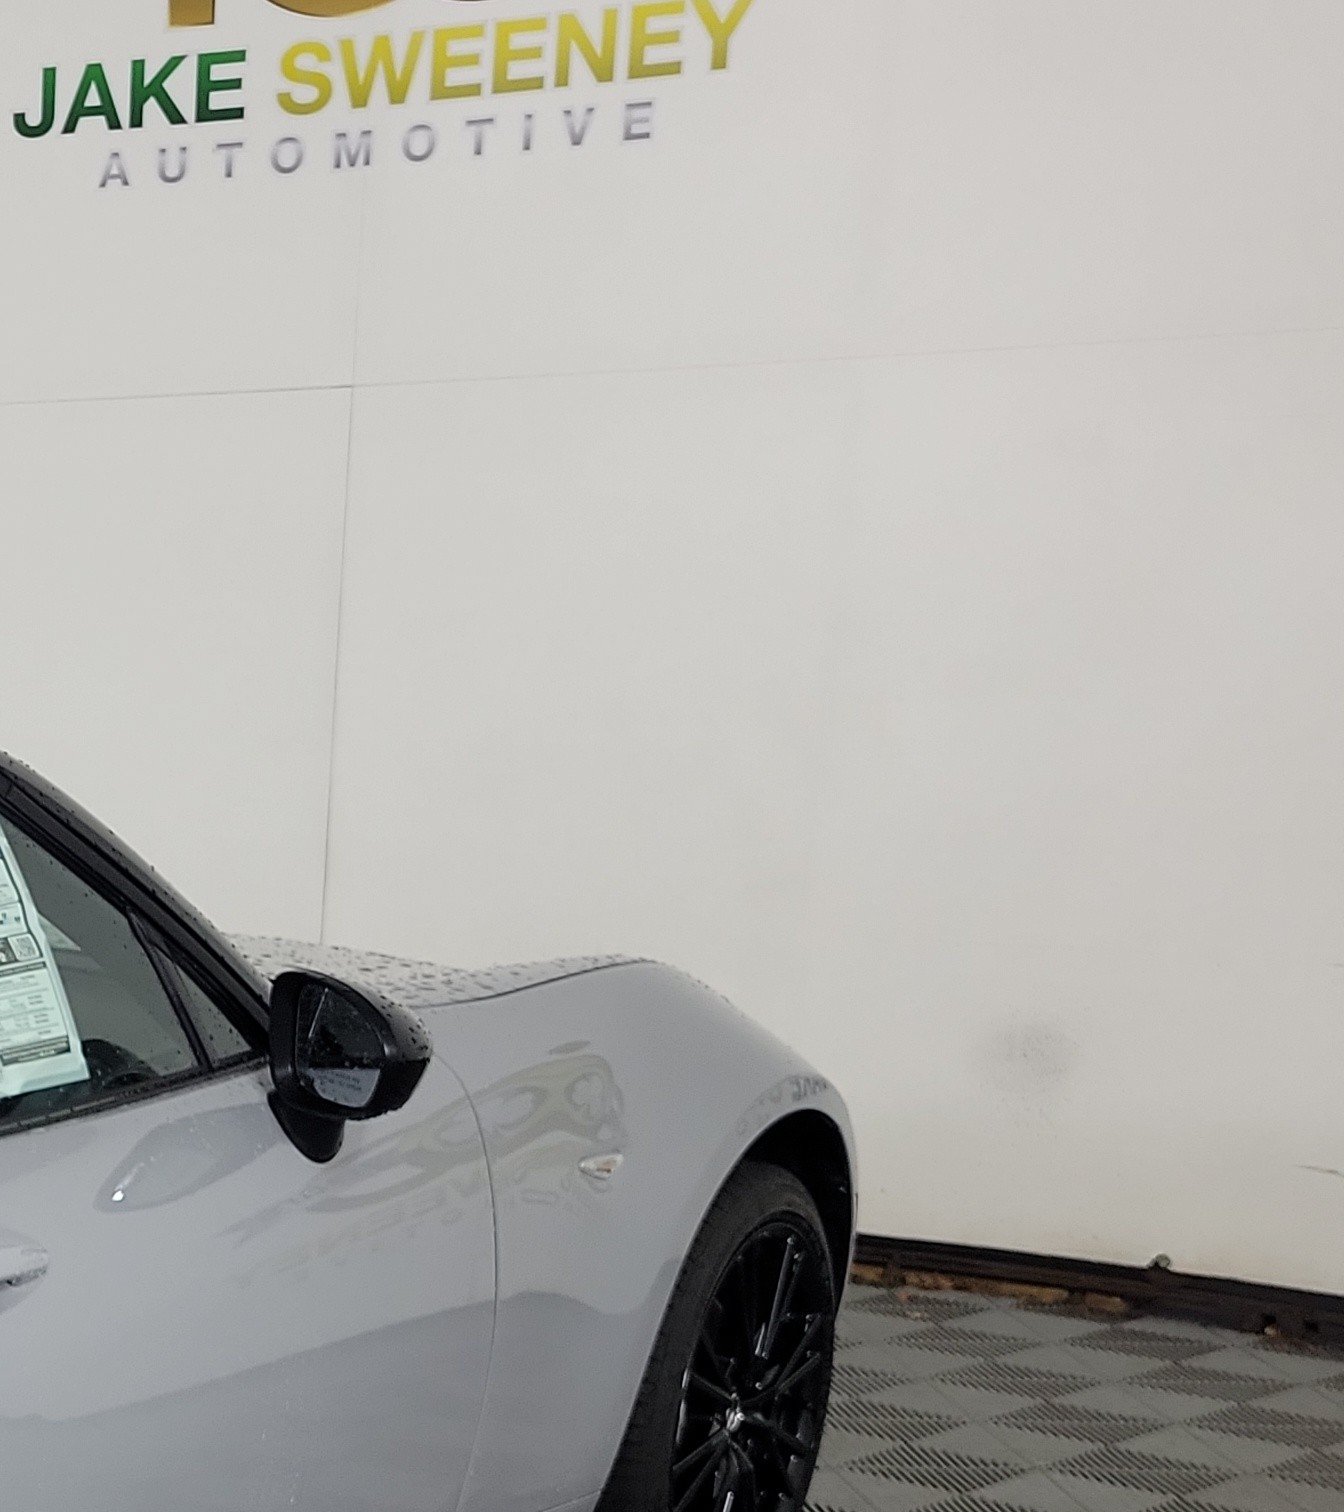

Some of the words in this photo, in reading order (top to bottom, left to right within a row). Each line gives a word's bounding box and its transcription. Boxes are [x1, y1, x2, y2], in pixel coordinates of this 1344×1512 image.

[12, 49, 247, 139] JAKE
[276, 0, 756, 117] SWEENEY
[98, 101, 654, 189] AUTOMOTIVE
